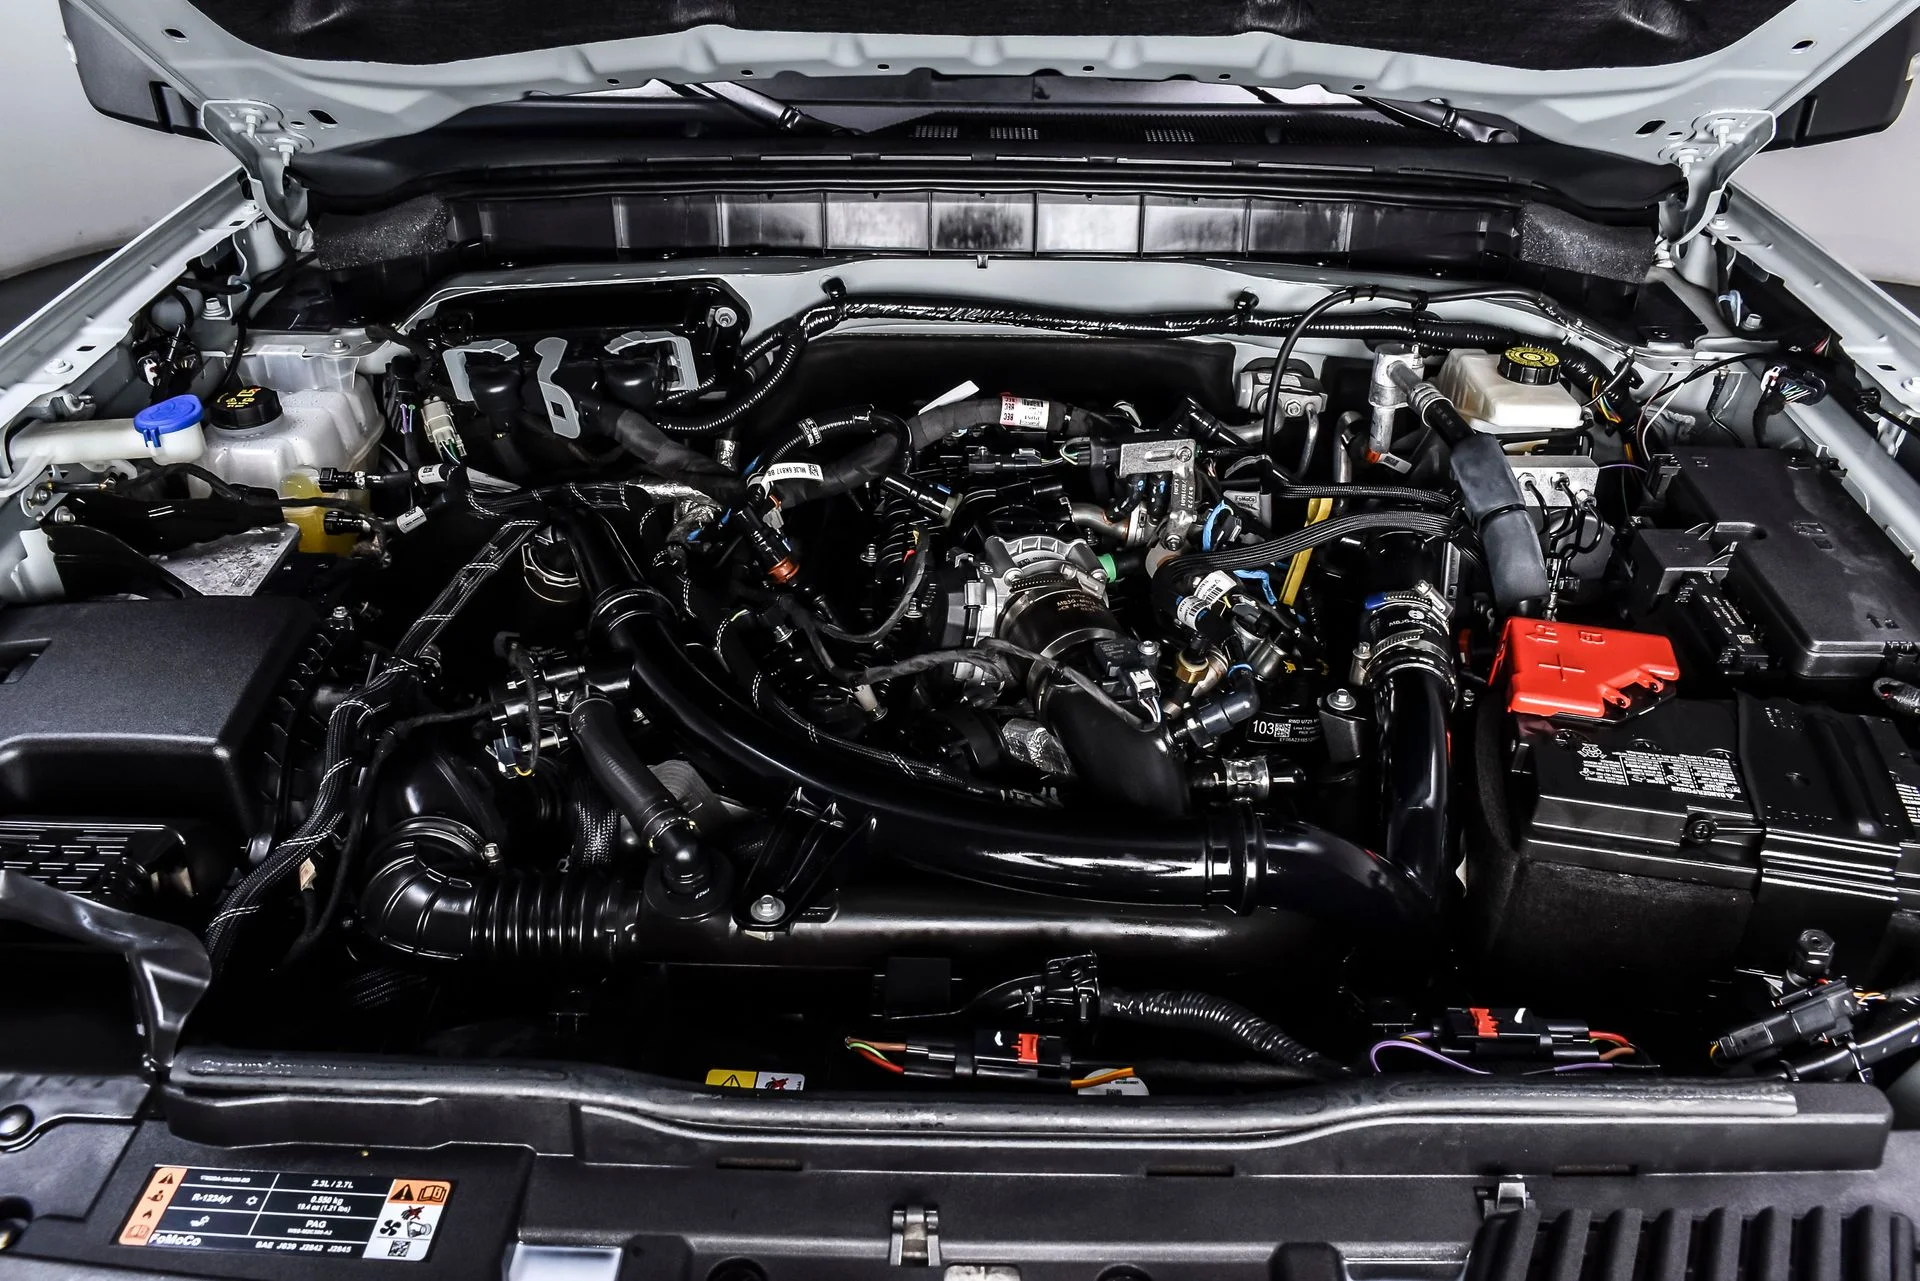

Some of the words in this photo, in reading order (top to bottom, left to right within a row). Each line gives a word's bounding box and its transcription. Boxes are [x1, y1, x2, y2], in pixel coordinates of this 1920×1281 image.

[1252, 719, 1275, 735] 103
[311, 1179, 329, 1188] 2.3L
[335, 1180, 354, 1189] 2.7L
[332, 1196, 344, 1206] kg
[305, 1219, 327, 1228] PAG
[148, 1232, 202, 1247] FoMoCo
